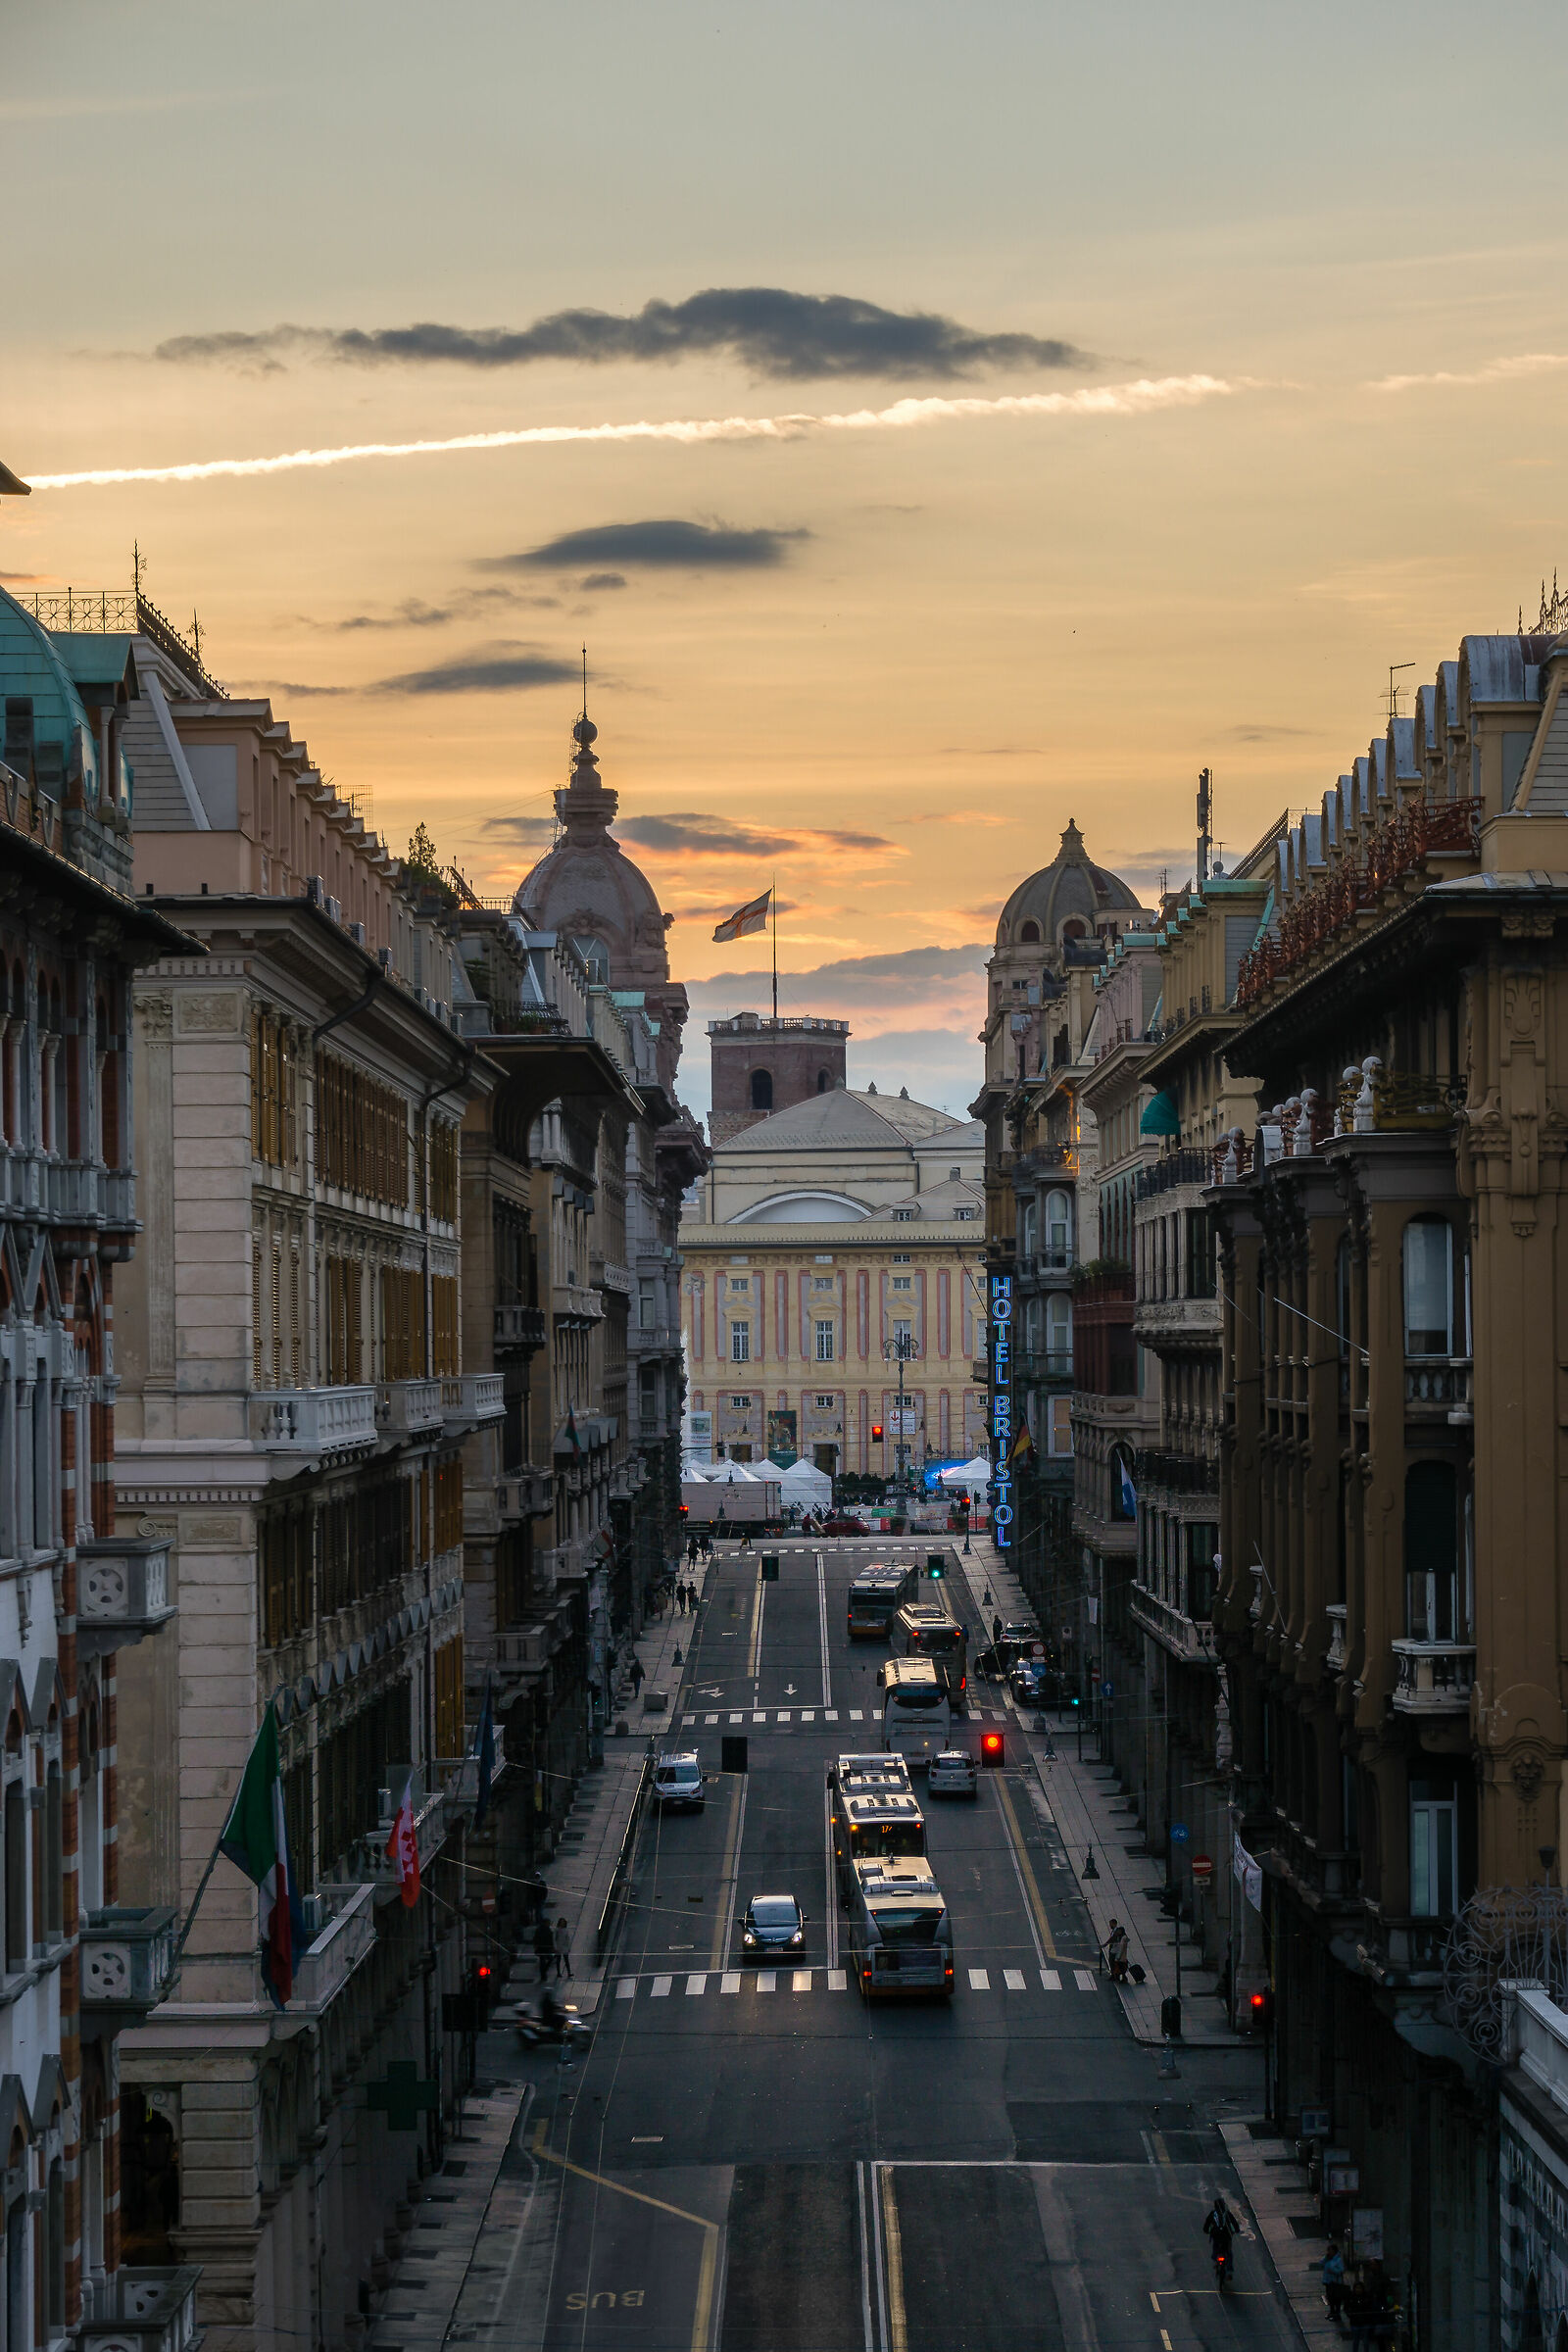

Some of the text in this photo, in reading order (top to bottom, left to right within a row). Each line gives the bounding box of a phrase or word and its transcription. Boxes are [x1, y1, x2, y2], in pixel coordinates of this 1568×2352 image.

[992, 1277, 1013, 1547] HOTEL BRISTOL
[565, 2289, 645, 2310] BUS
